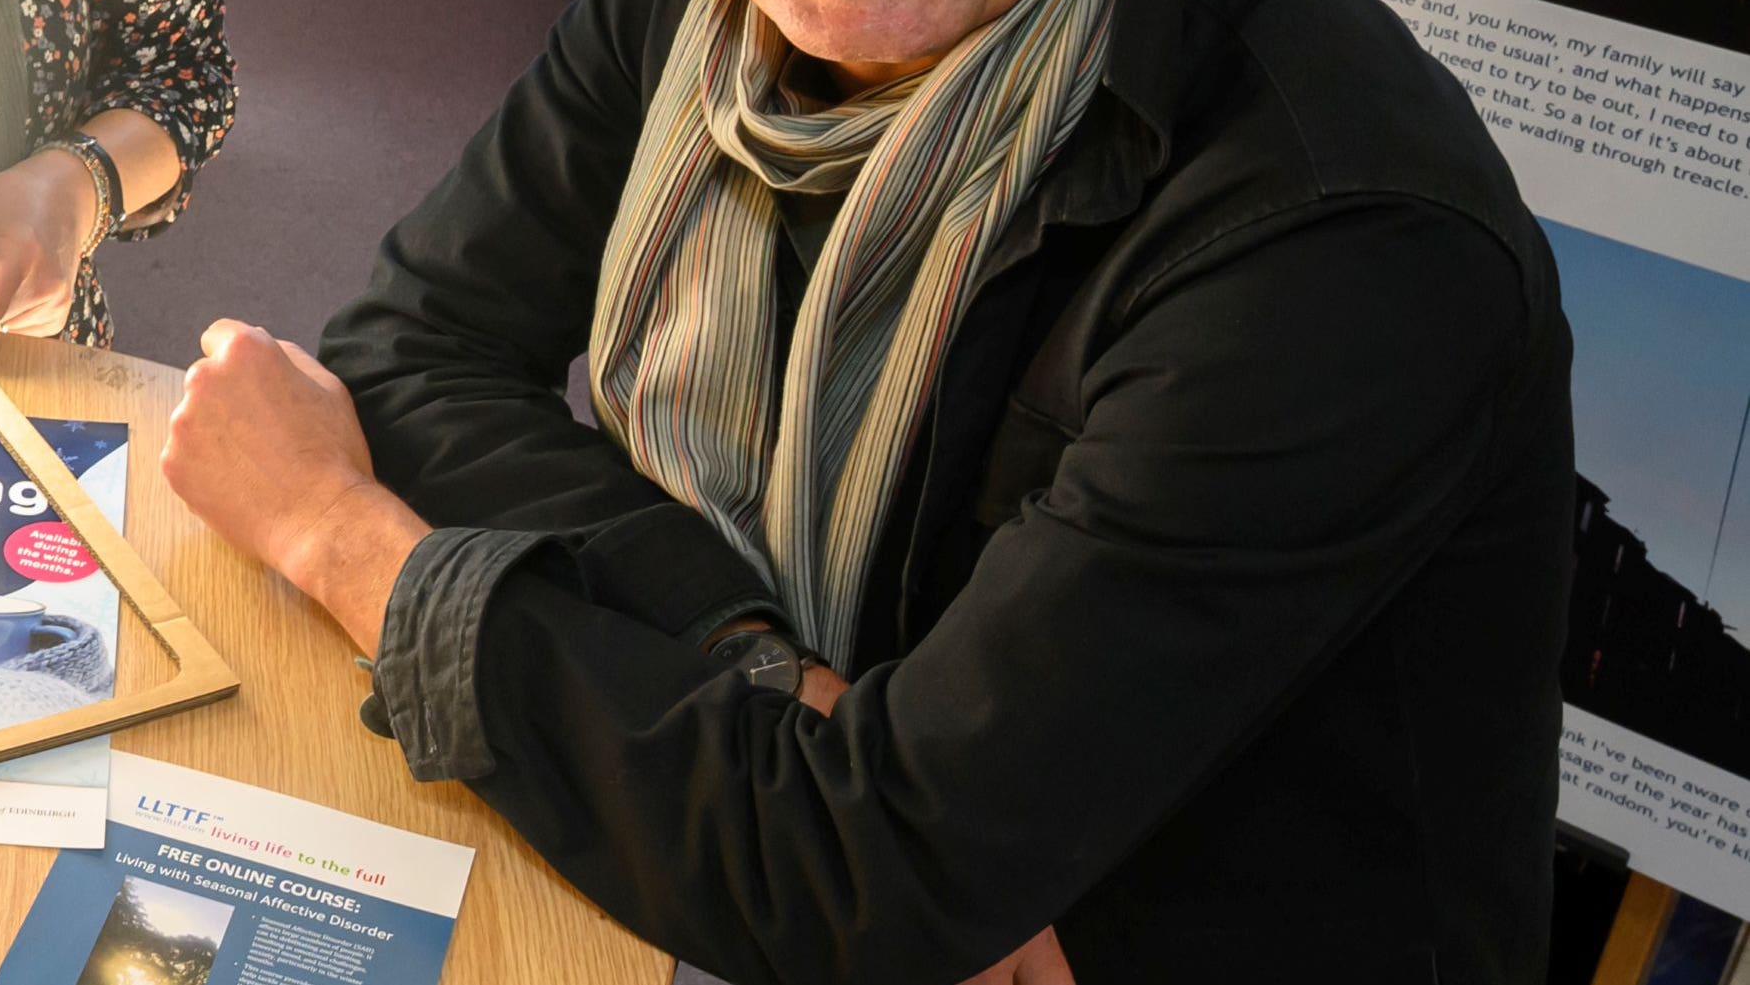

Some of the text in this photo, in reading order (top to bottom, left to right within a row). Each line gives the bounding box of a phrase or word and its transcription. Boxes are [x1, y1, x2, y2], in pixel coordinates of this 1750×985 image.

[1421, 0, 1459, 20] and,
[1466, 11, 1500, 29] you
[1505, 18, 1557, 47] know,
[1566, 38, 1596, 57] my
[1602, 44, 1663, 75] family
[1670, 65, 1705, 85] will
[1711, 77, 1745, 98] say
[1423, 21, 1459, 42] just
[1466, 33, 1496, 51] the
[1502, 45, 1563, 73] usual',
[1572, 64, 1609, 83] and
[1614, 75, 1661, 98] what
[1668, 87, 1750, 123] happens
[1438, 51, 1738, 144] need to try to be out, I need to
[1519, 121, 1585, 153] wading
[1591, 141, 1665, 174] through
[1672, 165, 1748, 199] treacle.
[17, 546, 88, 569] the winter
[18, 558, 76, 577] months.
[29, 529, 82, 548] Availab
[33, 540, 79, 558] during
[1591, 739, 1627, 762] I've
[1631, 756, 1676, 785] been
[1682, 782, 1739, 809] aware
[1609, 771, 1629, 784] of
[1634, 780, 1663, 797] the
[1669, 797, 1711, 820] year
[1716, 814, 1746, 837] has
[7, 806, 79, 820] EDINBURGH
[137, 795, 213, 825] LLTTF
[1561, 773, 1578, 786] at
[1584, 781, 1658, 822] random,
[1665, 816, 1725, 846] you're
[157, 844, 362, 914] FREE ONLINE COURSE:
[210, 826, 387, 887] living life to the full
[115, 851, 395, 942] Living with Seasonal Affective Disorder
